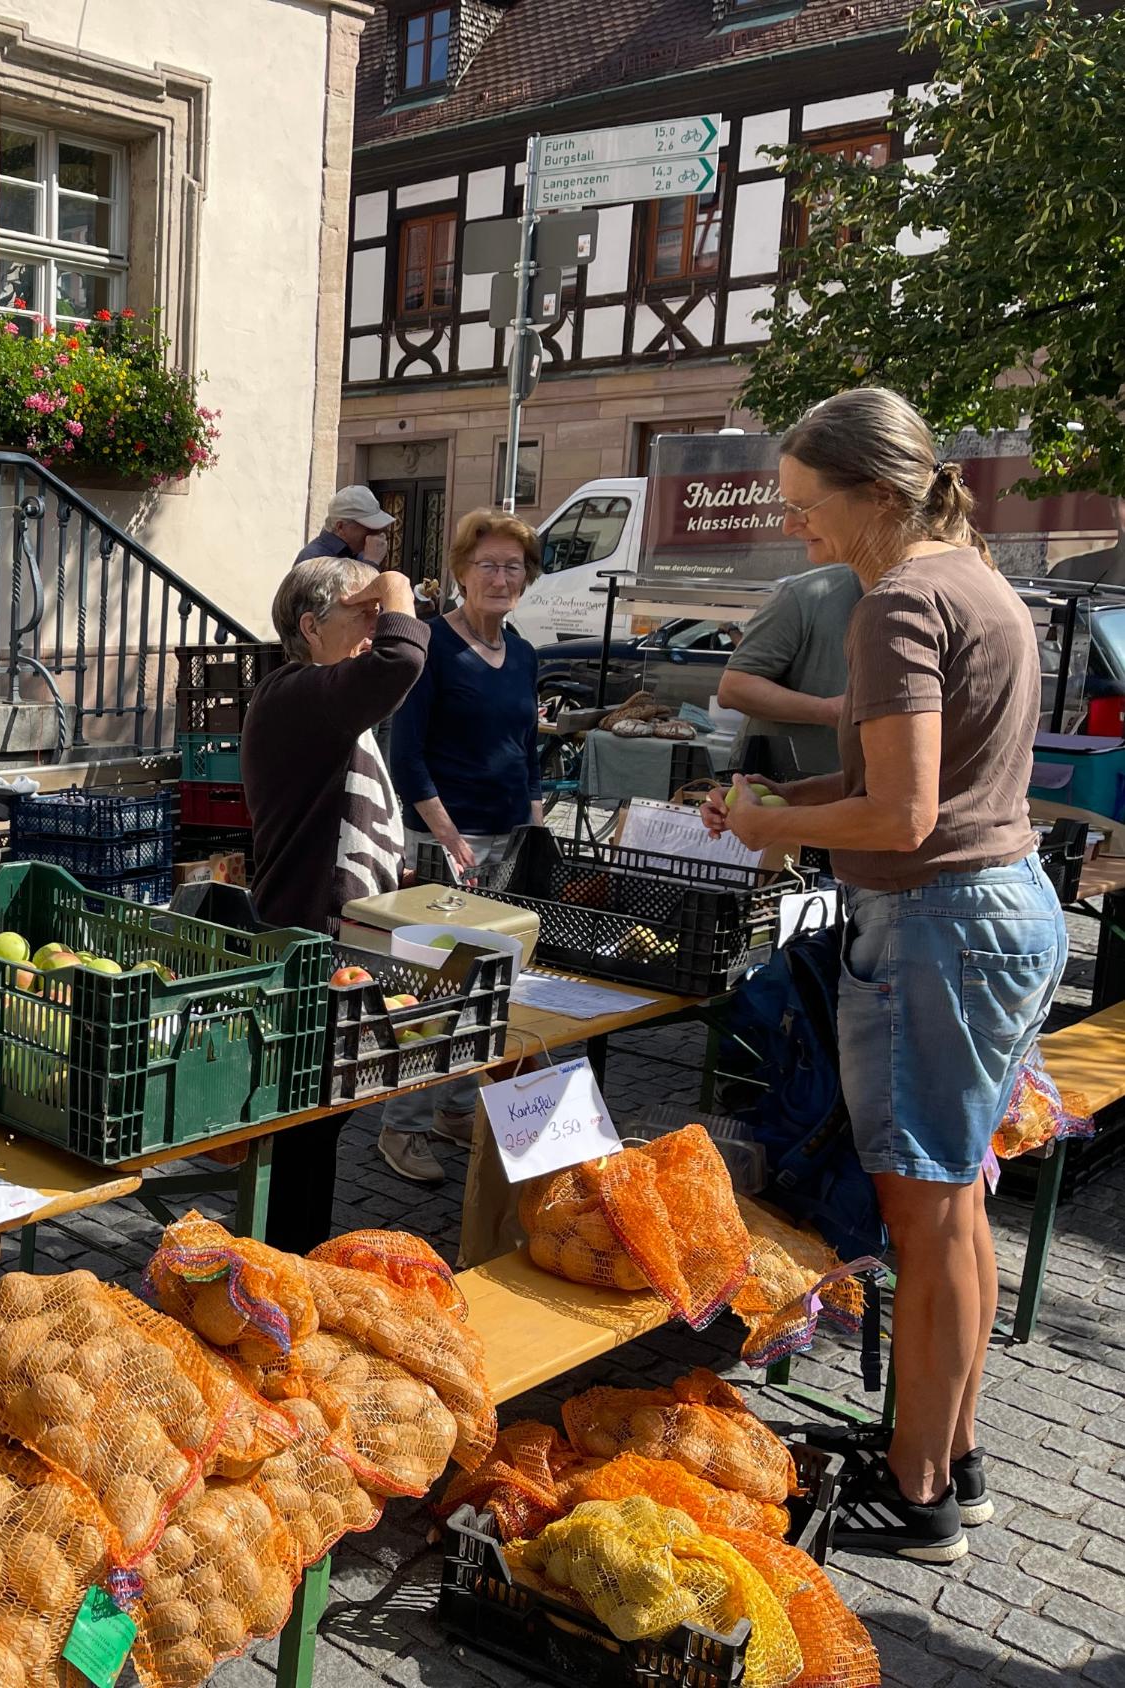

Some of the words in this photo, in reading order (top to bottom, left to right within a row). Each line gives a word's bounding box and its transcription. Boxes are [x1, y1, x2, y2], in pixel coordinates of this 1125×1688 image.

[545, 139, 575, 153] Fürth
[544, 151, 594, 167] Burgstall
[543, 174, 609, 190] Langenzenn
[542, 190, 596, 203] Steinbach
[507, 1093, 557, 1123] Kartoffel
[549, 1119, 581, 1141] 3,50
